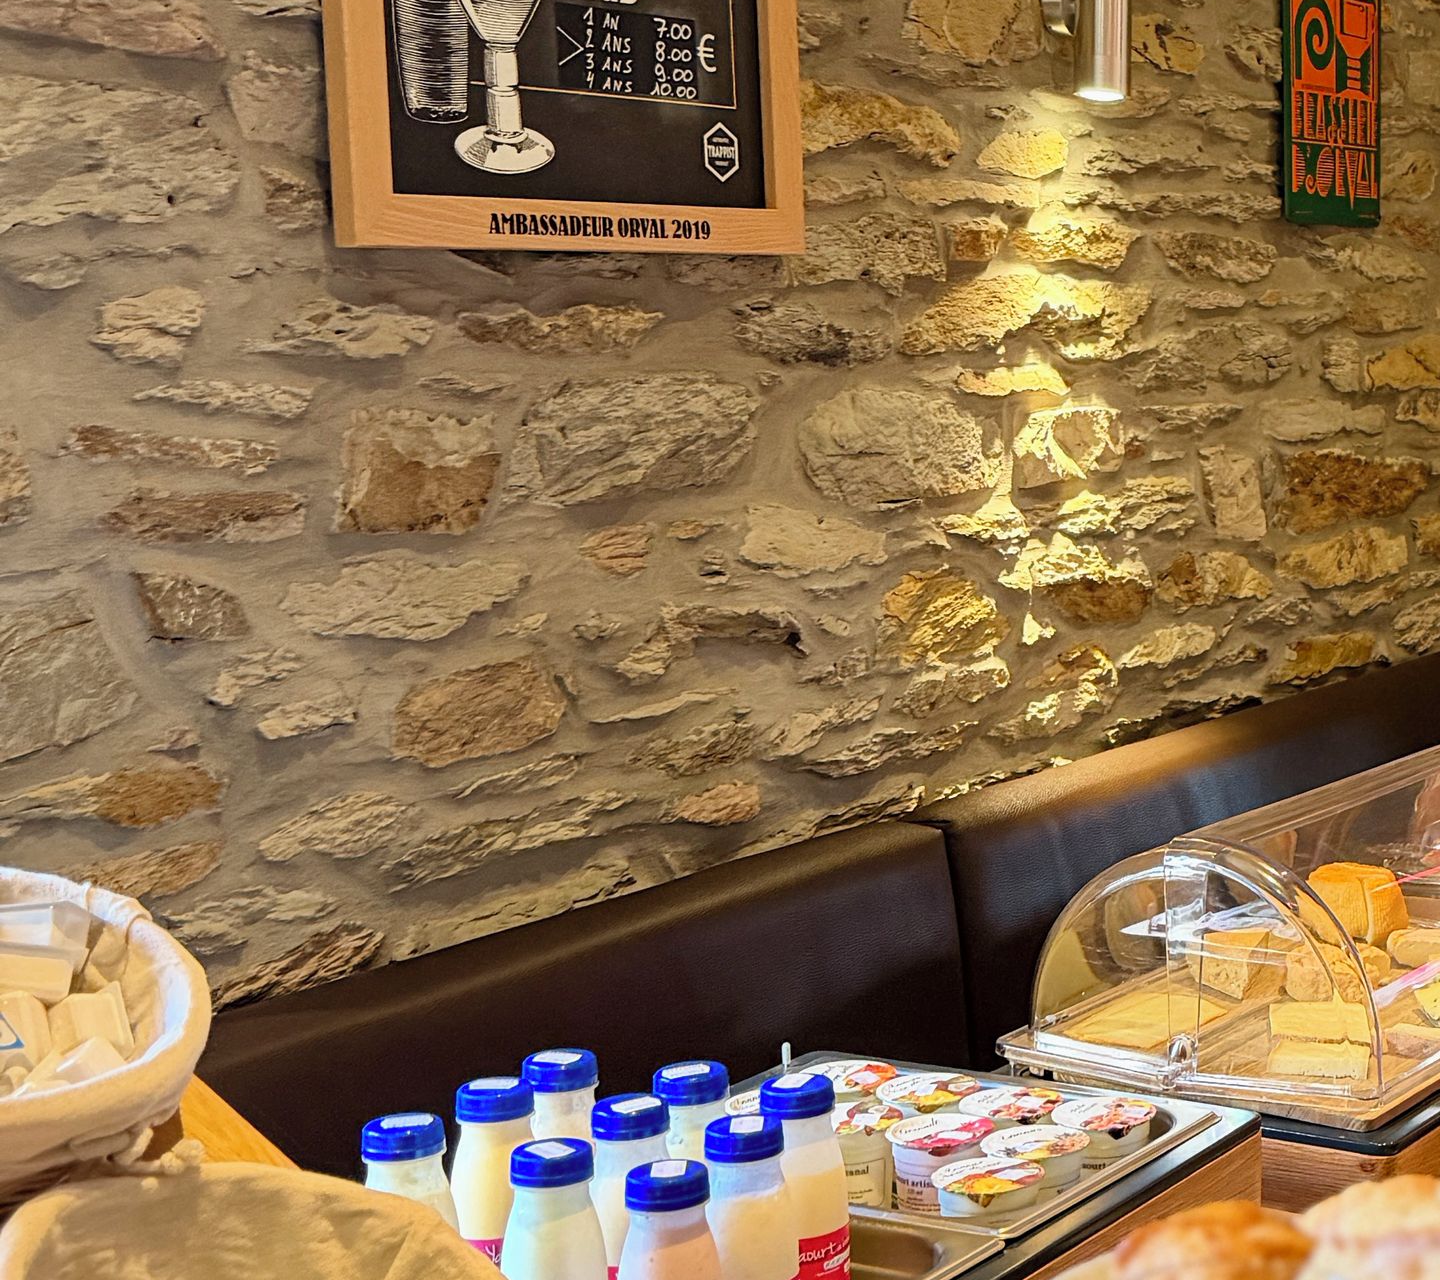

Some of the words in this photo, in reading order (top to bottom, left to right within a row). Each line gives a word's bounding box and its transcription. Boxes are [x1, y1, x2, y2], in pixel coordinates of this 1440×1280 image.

[583, 7, 595, 26] 1
[602, 12, 620, 31] AN
[653, 17, 692, 41] 7.00
[602, 33, 632, 55] ANS
[655, 41, 693, 63] 8.00
[585, 52, 596, 71] 3
[602, 56, 633, 74] ANS
[654, 63, 694, 83] 9.00
[585, 72, 596, 90] 4
[602, 77, 633, 94] ANS
[650, 83, 698, 100] 10.00
[489, 213, 615, 238] AMBASSADEUR
[618, 217, 669, 240] ORVAL
[671, 219, 711, 240] 2019
